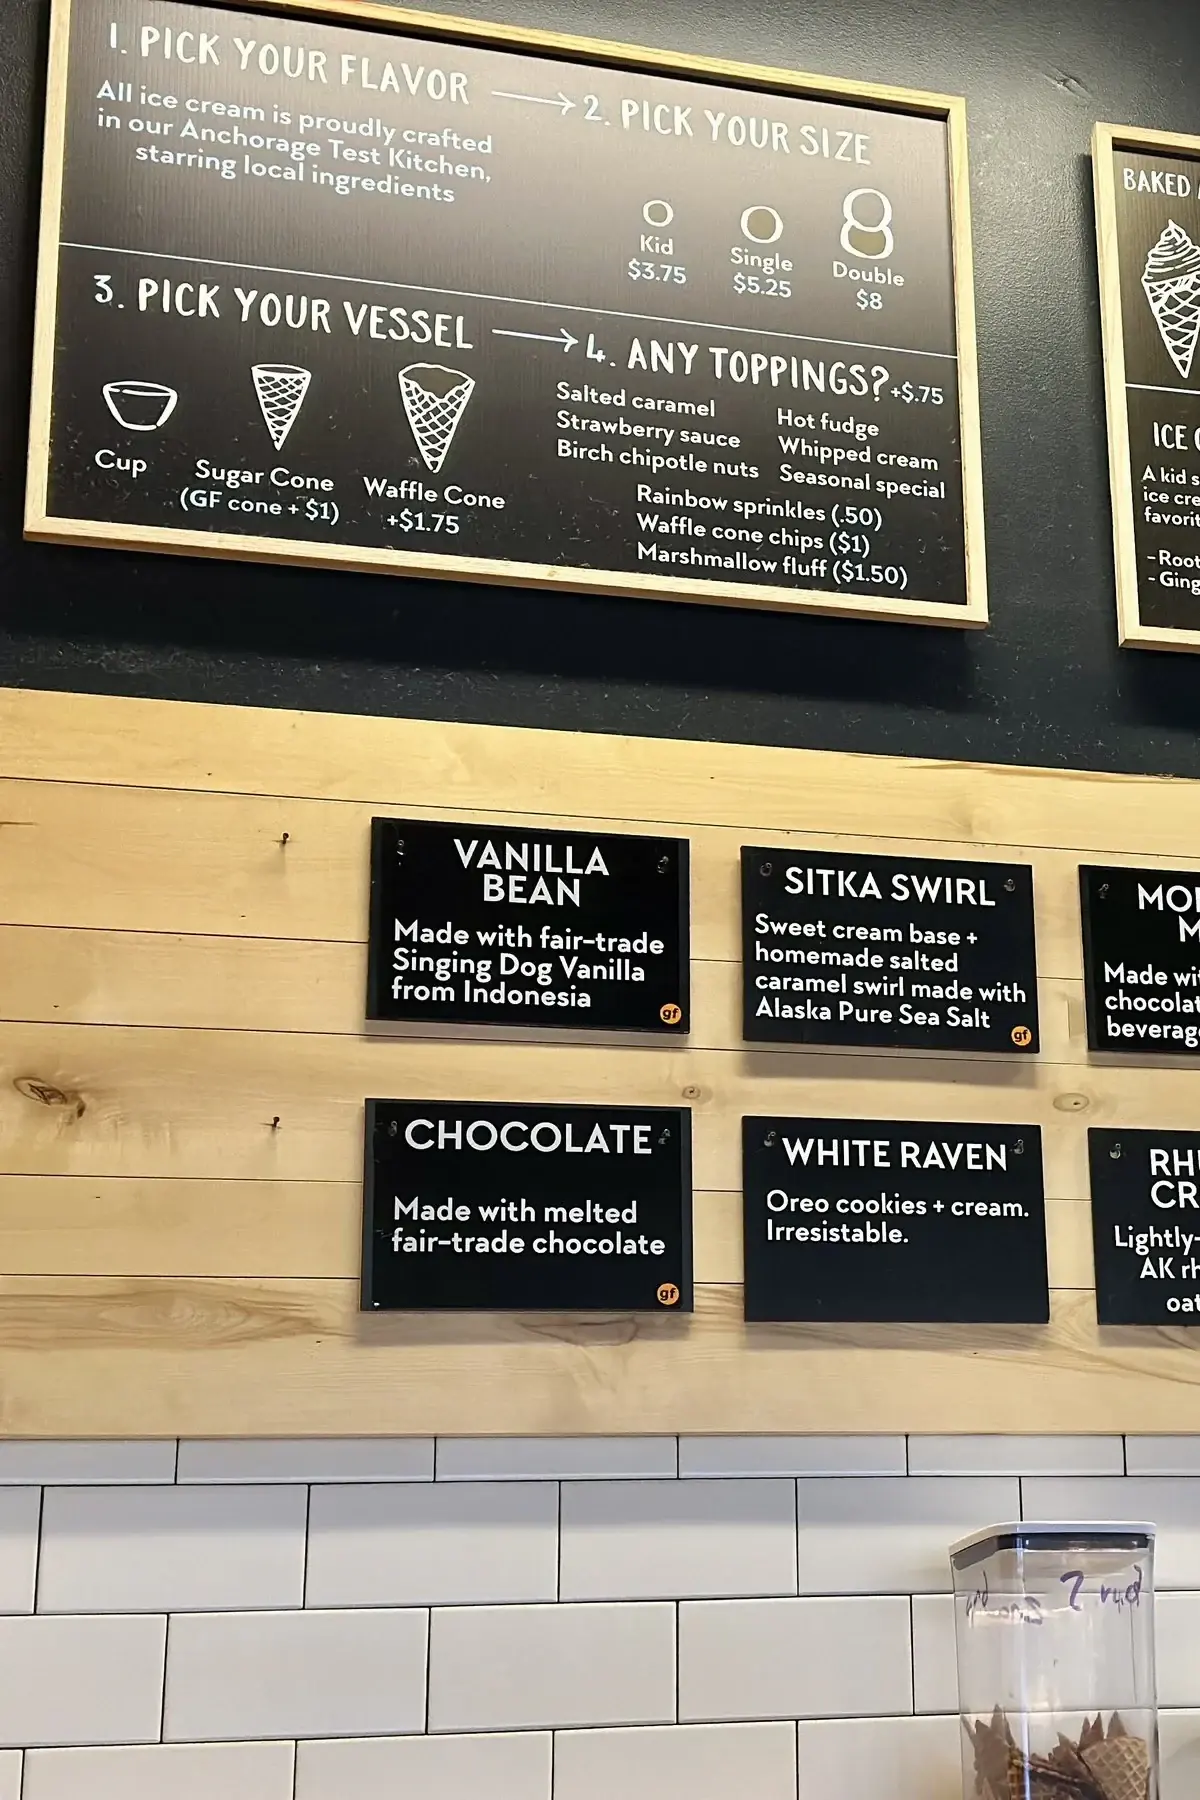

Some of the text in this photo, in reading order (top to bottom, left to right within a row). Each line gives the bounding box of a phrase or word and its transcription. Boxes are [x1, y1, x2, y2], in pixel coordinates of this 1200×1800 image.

[110, 22, 470, 104] 1. PICK YOUR FLAVOR
[583, 94, 871, 165] 2. PICK YOUR SIZE
[135, 144, 455, 203] starring local ingredients
[1124, 168, 1191, 198] BAKED
[640, 234, 674, 256] Kid
[730, 246, 793, 275] Single
[627, 257, 687, 284] $3.75
[732, 271, 792, 298] $5.25
[832, 260, 905, 287] Double
[93, 274, 474, 349] 3. PICK YOUR VESSEL
[856, 288, 883, 311] $8
[586, 333, 889, 401] 4. ANY TOPPINGS?
[556, 381, 715, 418] Salted caramel
[890, 381, 944, 405] +$.75
[777, 407, 880, 441] Hot fudge
[1153, 421, 1189, 451] ICE
[94, 449, 147, 479] Cup
[195, 459, 335, 492] Sugar Cone
[362, 476, 506, 509] Waffle Cone
[779, 463, 945, 499] Seasonal special
[386, 507, 460, 534] +$1.75
[637, 483, 883, 532] Rainbow sprinkles (.50)
[453, 838, 610, 876] VANILLA
[483, 873, 580, 908] BEAN
[784, 866, 996, 907] SITKA SWIRL
[391, 975, 591, 1008] from Indonesia
[755, 995, 991, 1029] Alaska Pure Sea Salt
[404, 1118, 652, 1155] CHOCOLATE
[781, 1137, 1007, 1171] WHITE RAVEN
[391, 1227, 666, 1256] fair-trade chocolate
[767, 1218, 909, 1244] Irresistable.
